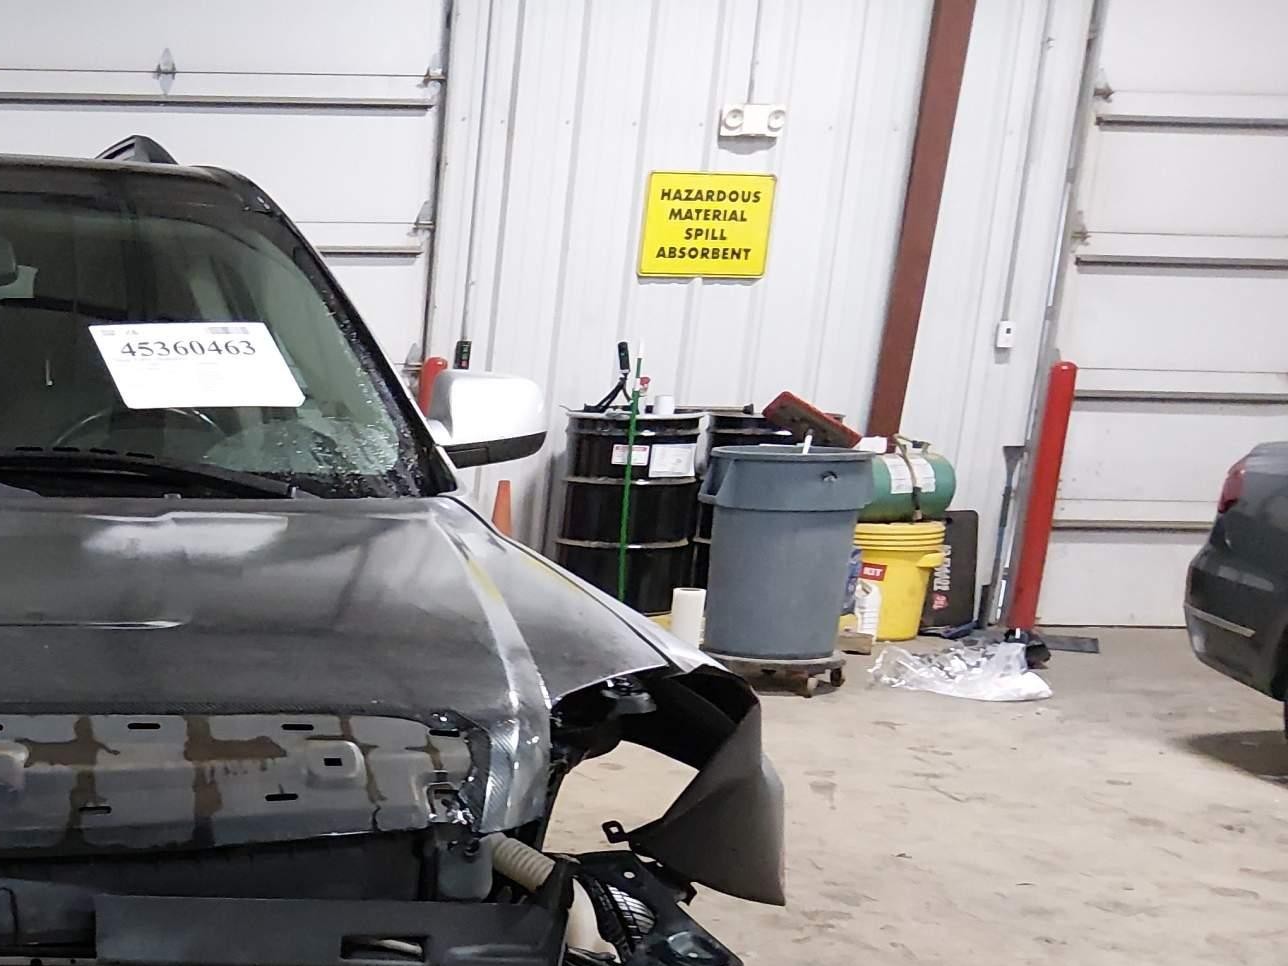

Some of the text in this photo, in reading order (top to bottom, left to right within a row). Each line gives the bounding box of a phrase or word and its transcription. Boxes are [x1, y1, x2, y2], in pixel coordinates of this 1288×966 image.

[660, 188, 762, 203] HAZARDOUS
[668, 208, 748, 222] MATERIAL
[684, 227, 727, 241] SPILL
[655, 246, 752, 261] ABSORBENT
[120, 340, 256, 357] 45360463
